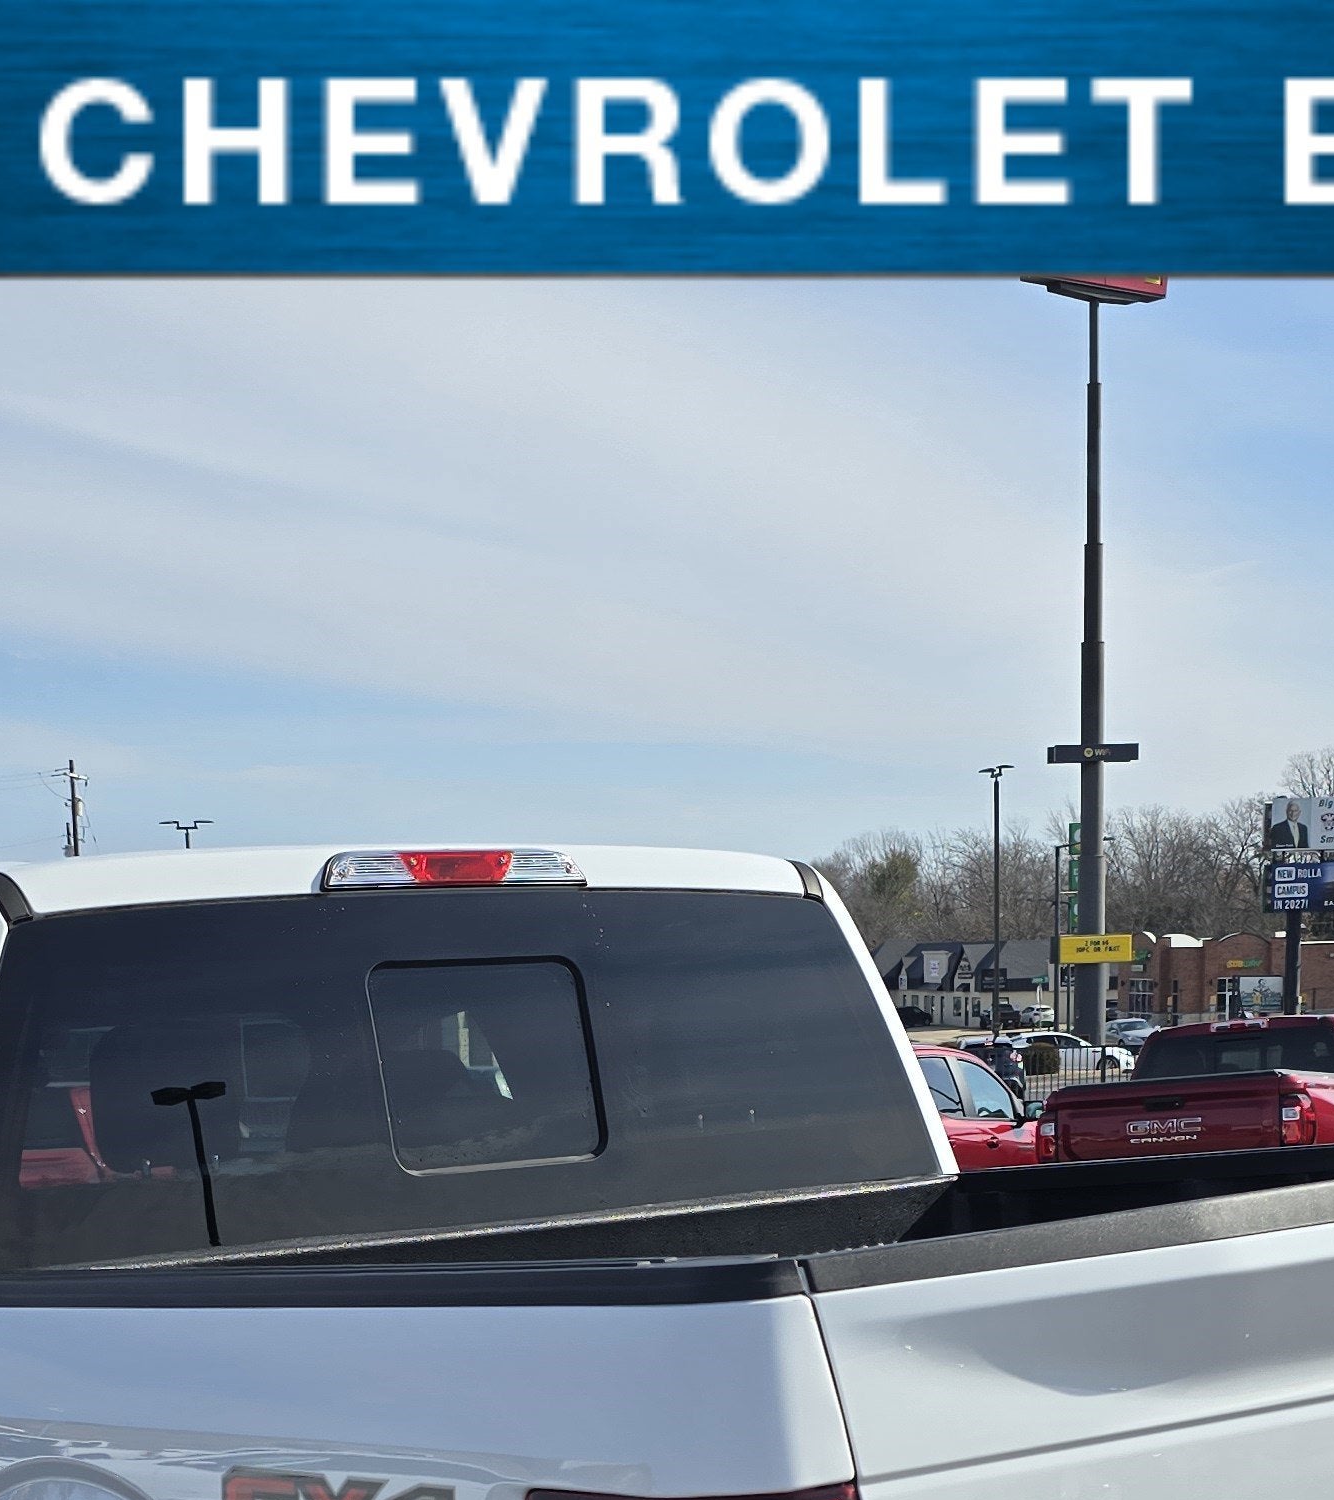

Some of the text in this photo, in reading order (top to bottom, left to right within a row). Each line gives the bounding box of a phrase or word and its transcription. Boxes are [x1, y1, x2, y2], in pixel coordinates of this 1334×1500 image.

[1318, 798, 1334, 809] Big
[1277, 868, 1322, 879] NEW ROLLA
[1277, 885, 1307, 895] CAMPUS
[1273, 899, 1283, 910] IN
[1126, 1117, 1202, 1136] GMC
[1129, 1134, 1198, 1144] CANYON
